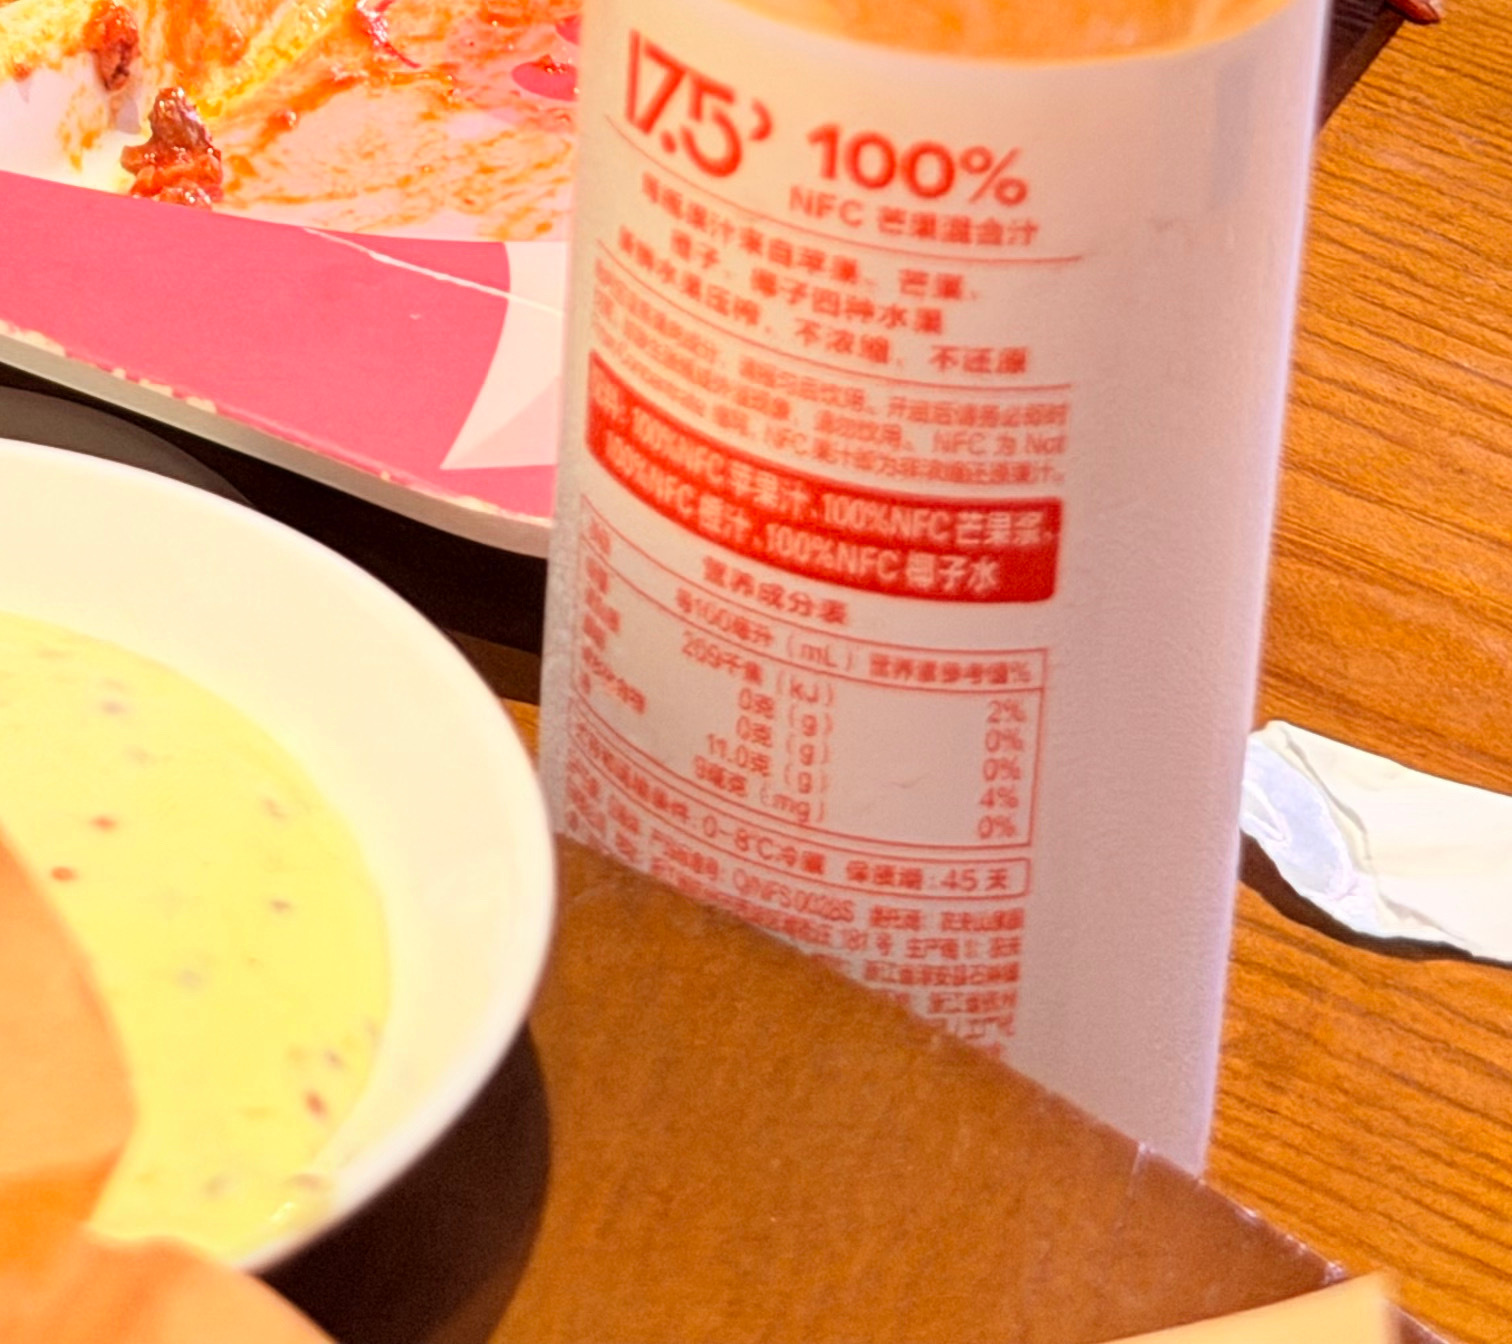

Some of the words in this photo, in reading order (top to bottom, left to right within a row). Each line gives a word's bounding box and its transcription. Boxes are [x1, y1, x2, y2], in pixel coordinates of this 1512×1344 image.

[806, 122, 1029, 208] 100%
[789, 185, 864, 229] NFC
[703, 556, 849, 625] 营养成分表
[986, 699, 1027, 724] 2%
[985, 728, 1024, 753] 0%
[983, 756, 1021, 782] 0%
[979, 786, 1020, 810] 4%
[977, 814, 1016, 841] 0%
